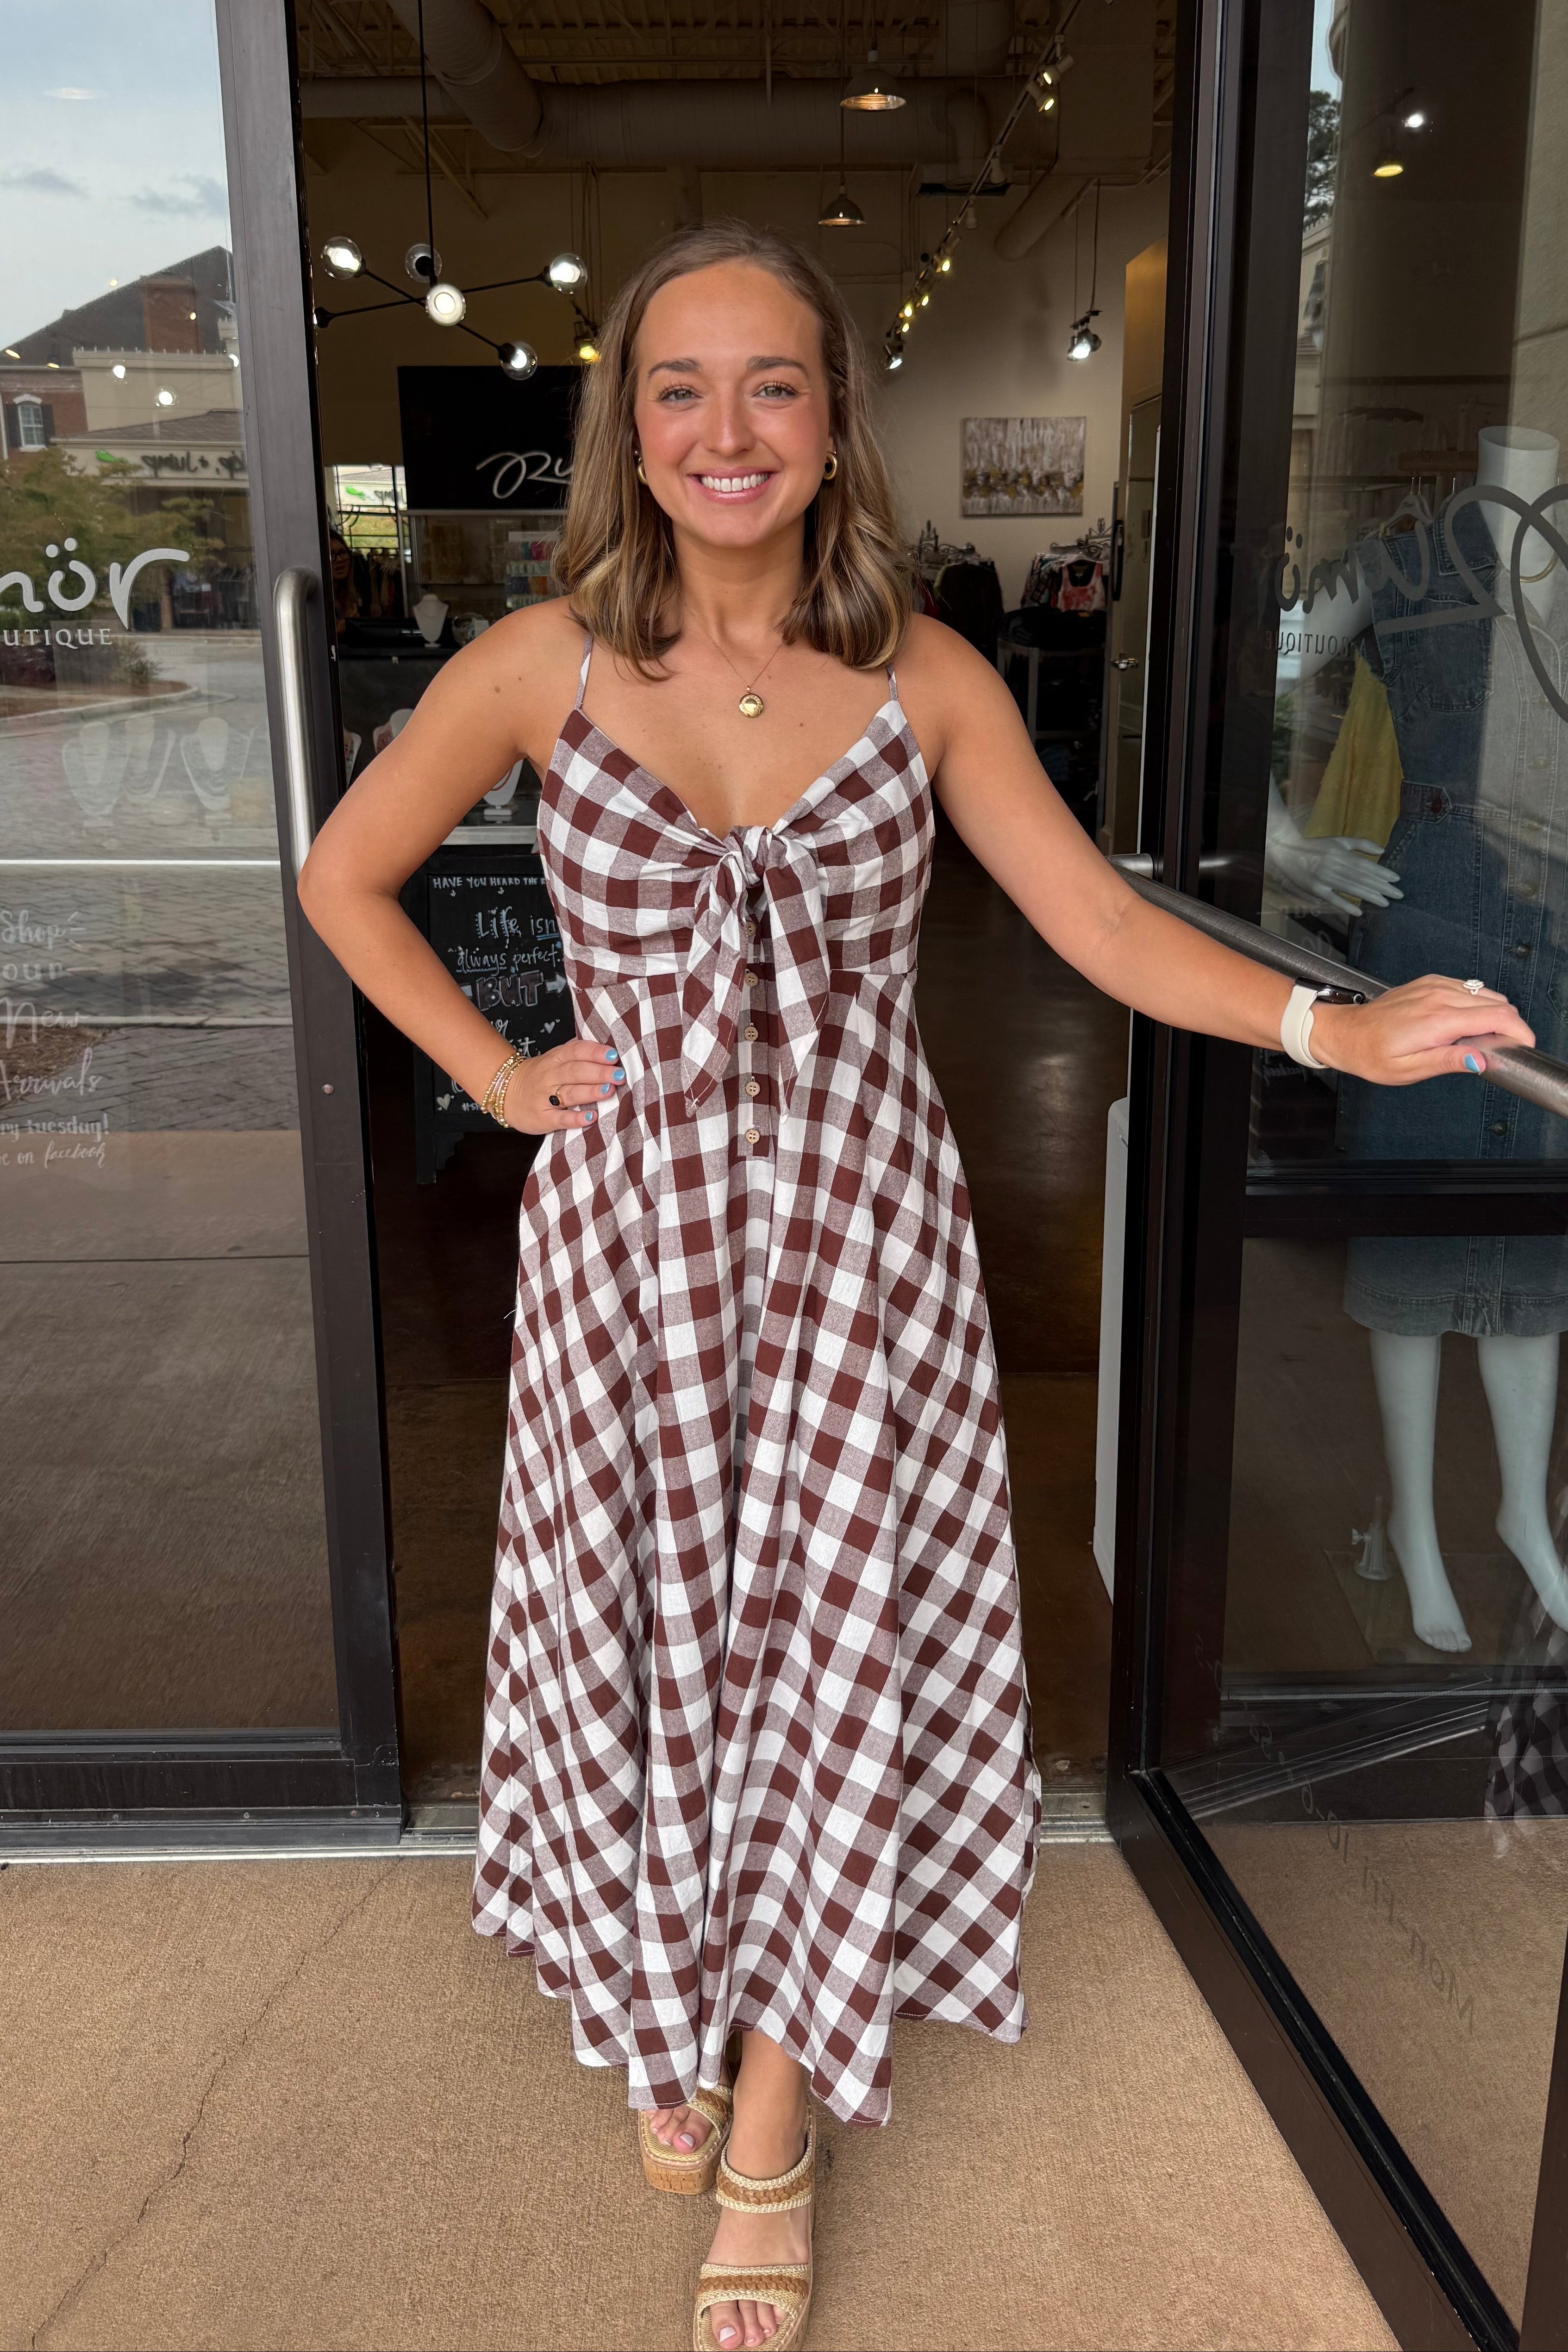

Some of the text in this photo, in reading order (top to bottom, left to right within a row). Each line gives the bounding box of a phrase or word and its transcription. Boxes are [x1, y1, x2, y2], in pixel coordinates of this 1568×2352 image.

[475, 451, 574, 499] Ru
[433, 877, 462, 889] HAVE
[467, 877, 486, 888] YOU
[490, 877, 520, 886] HEARD
[0, 910, 66, 950] Shop
[530, 915, 556, 936] isn
[3, 963, 63, 980] our
[476, 970, 543, 1011] BUT
[0, 997, 90, 1049] New
[26, 1113, 110, 1142] tuesday!
[18, 1151, 35, 1164] on
[45, 1140, 106, 1169] facebook
